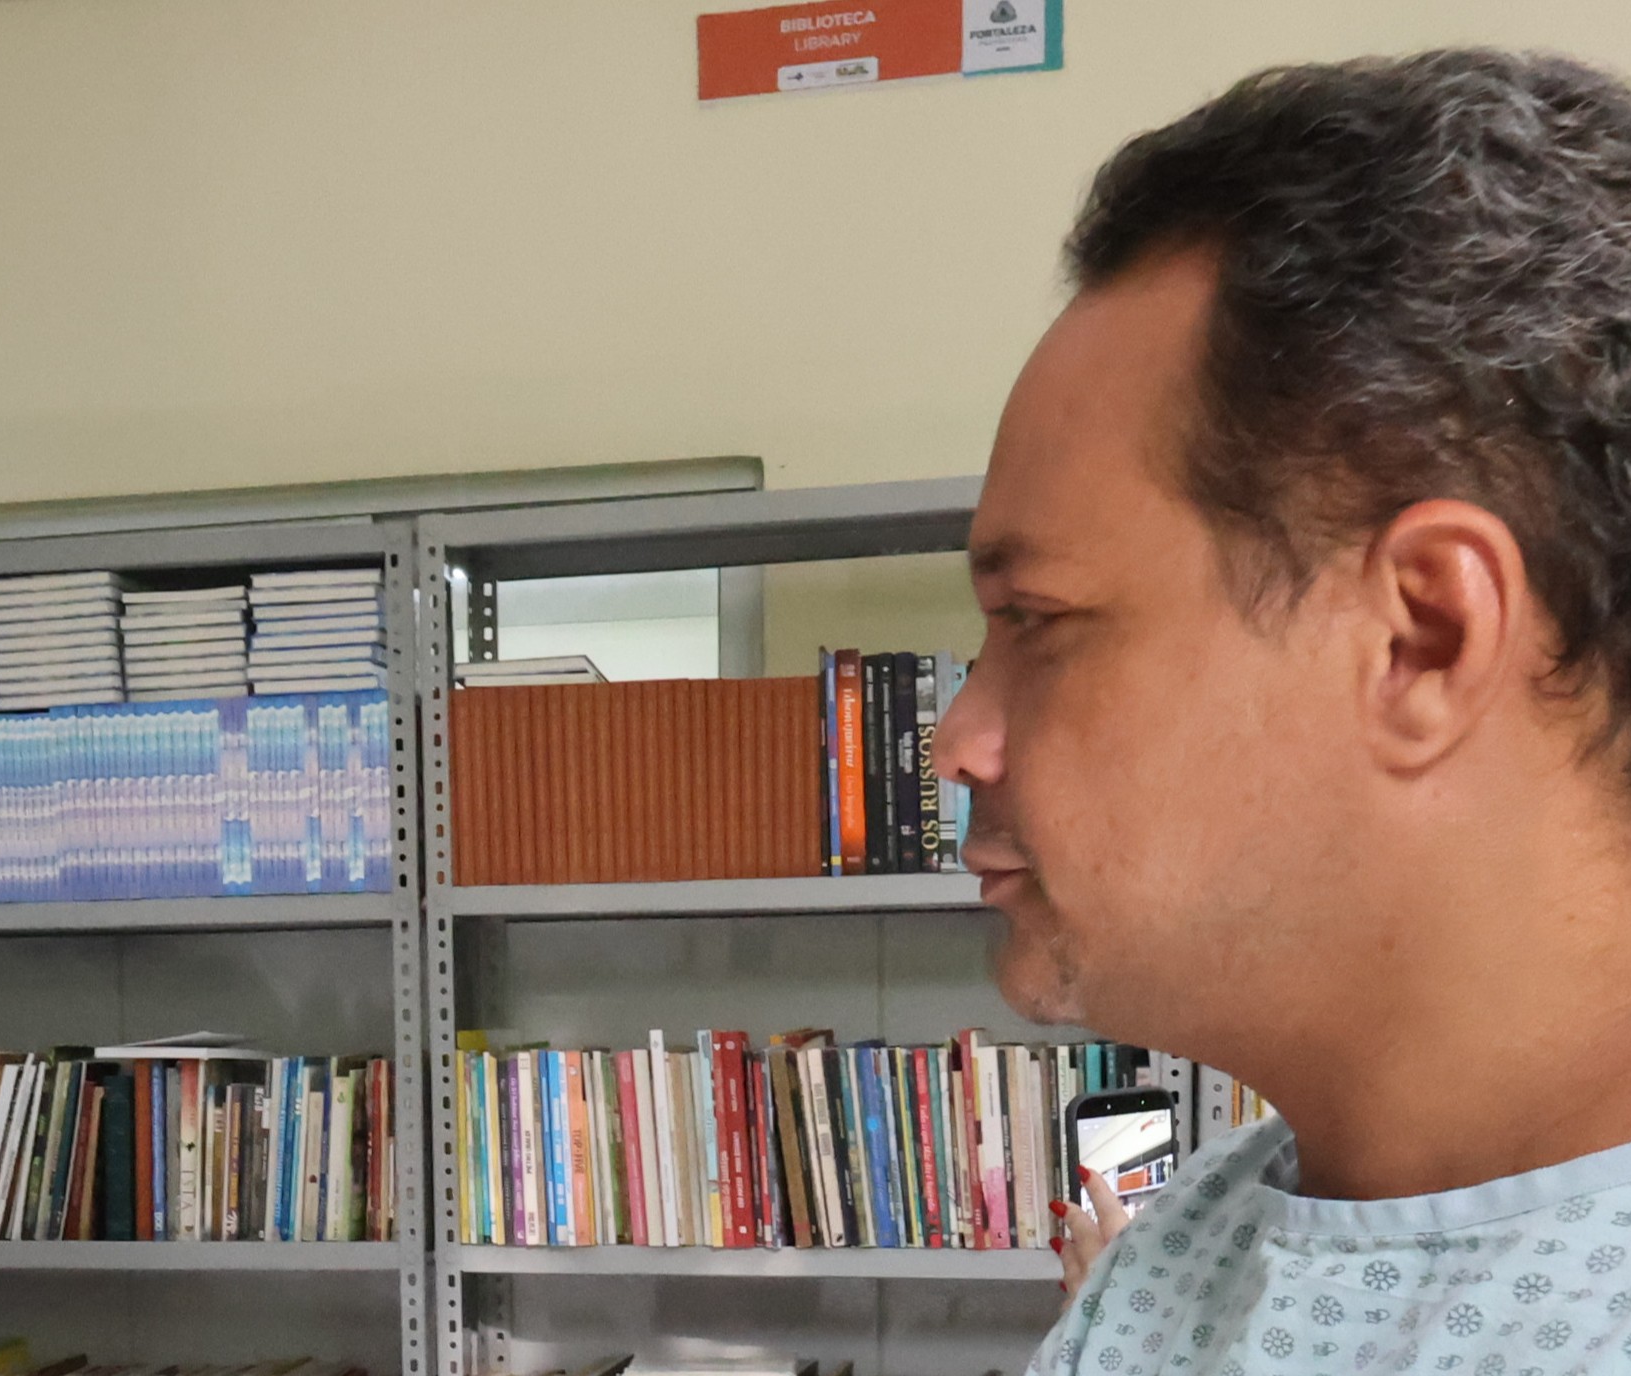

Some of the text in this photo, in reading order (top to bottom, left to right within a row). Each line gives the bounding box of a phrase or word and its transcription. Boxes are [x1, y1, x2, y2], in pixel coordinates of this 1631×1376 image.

[780, 10, 877, 34] BIBLIOTECA
[970, 24, 1037, 40] FORTALEZA
[794, 31, 863, 53] LIBRARY
[918, 726, 939, 850] OS RUSSOS
